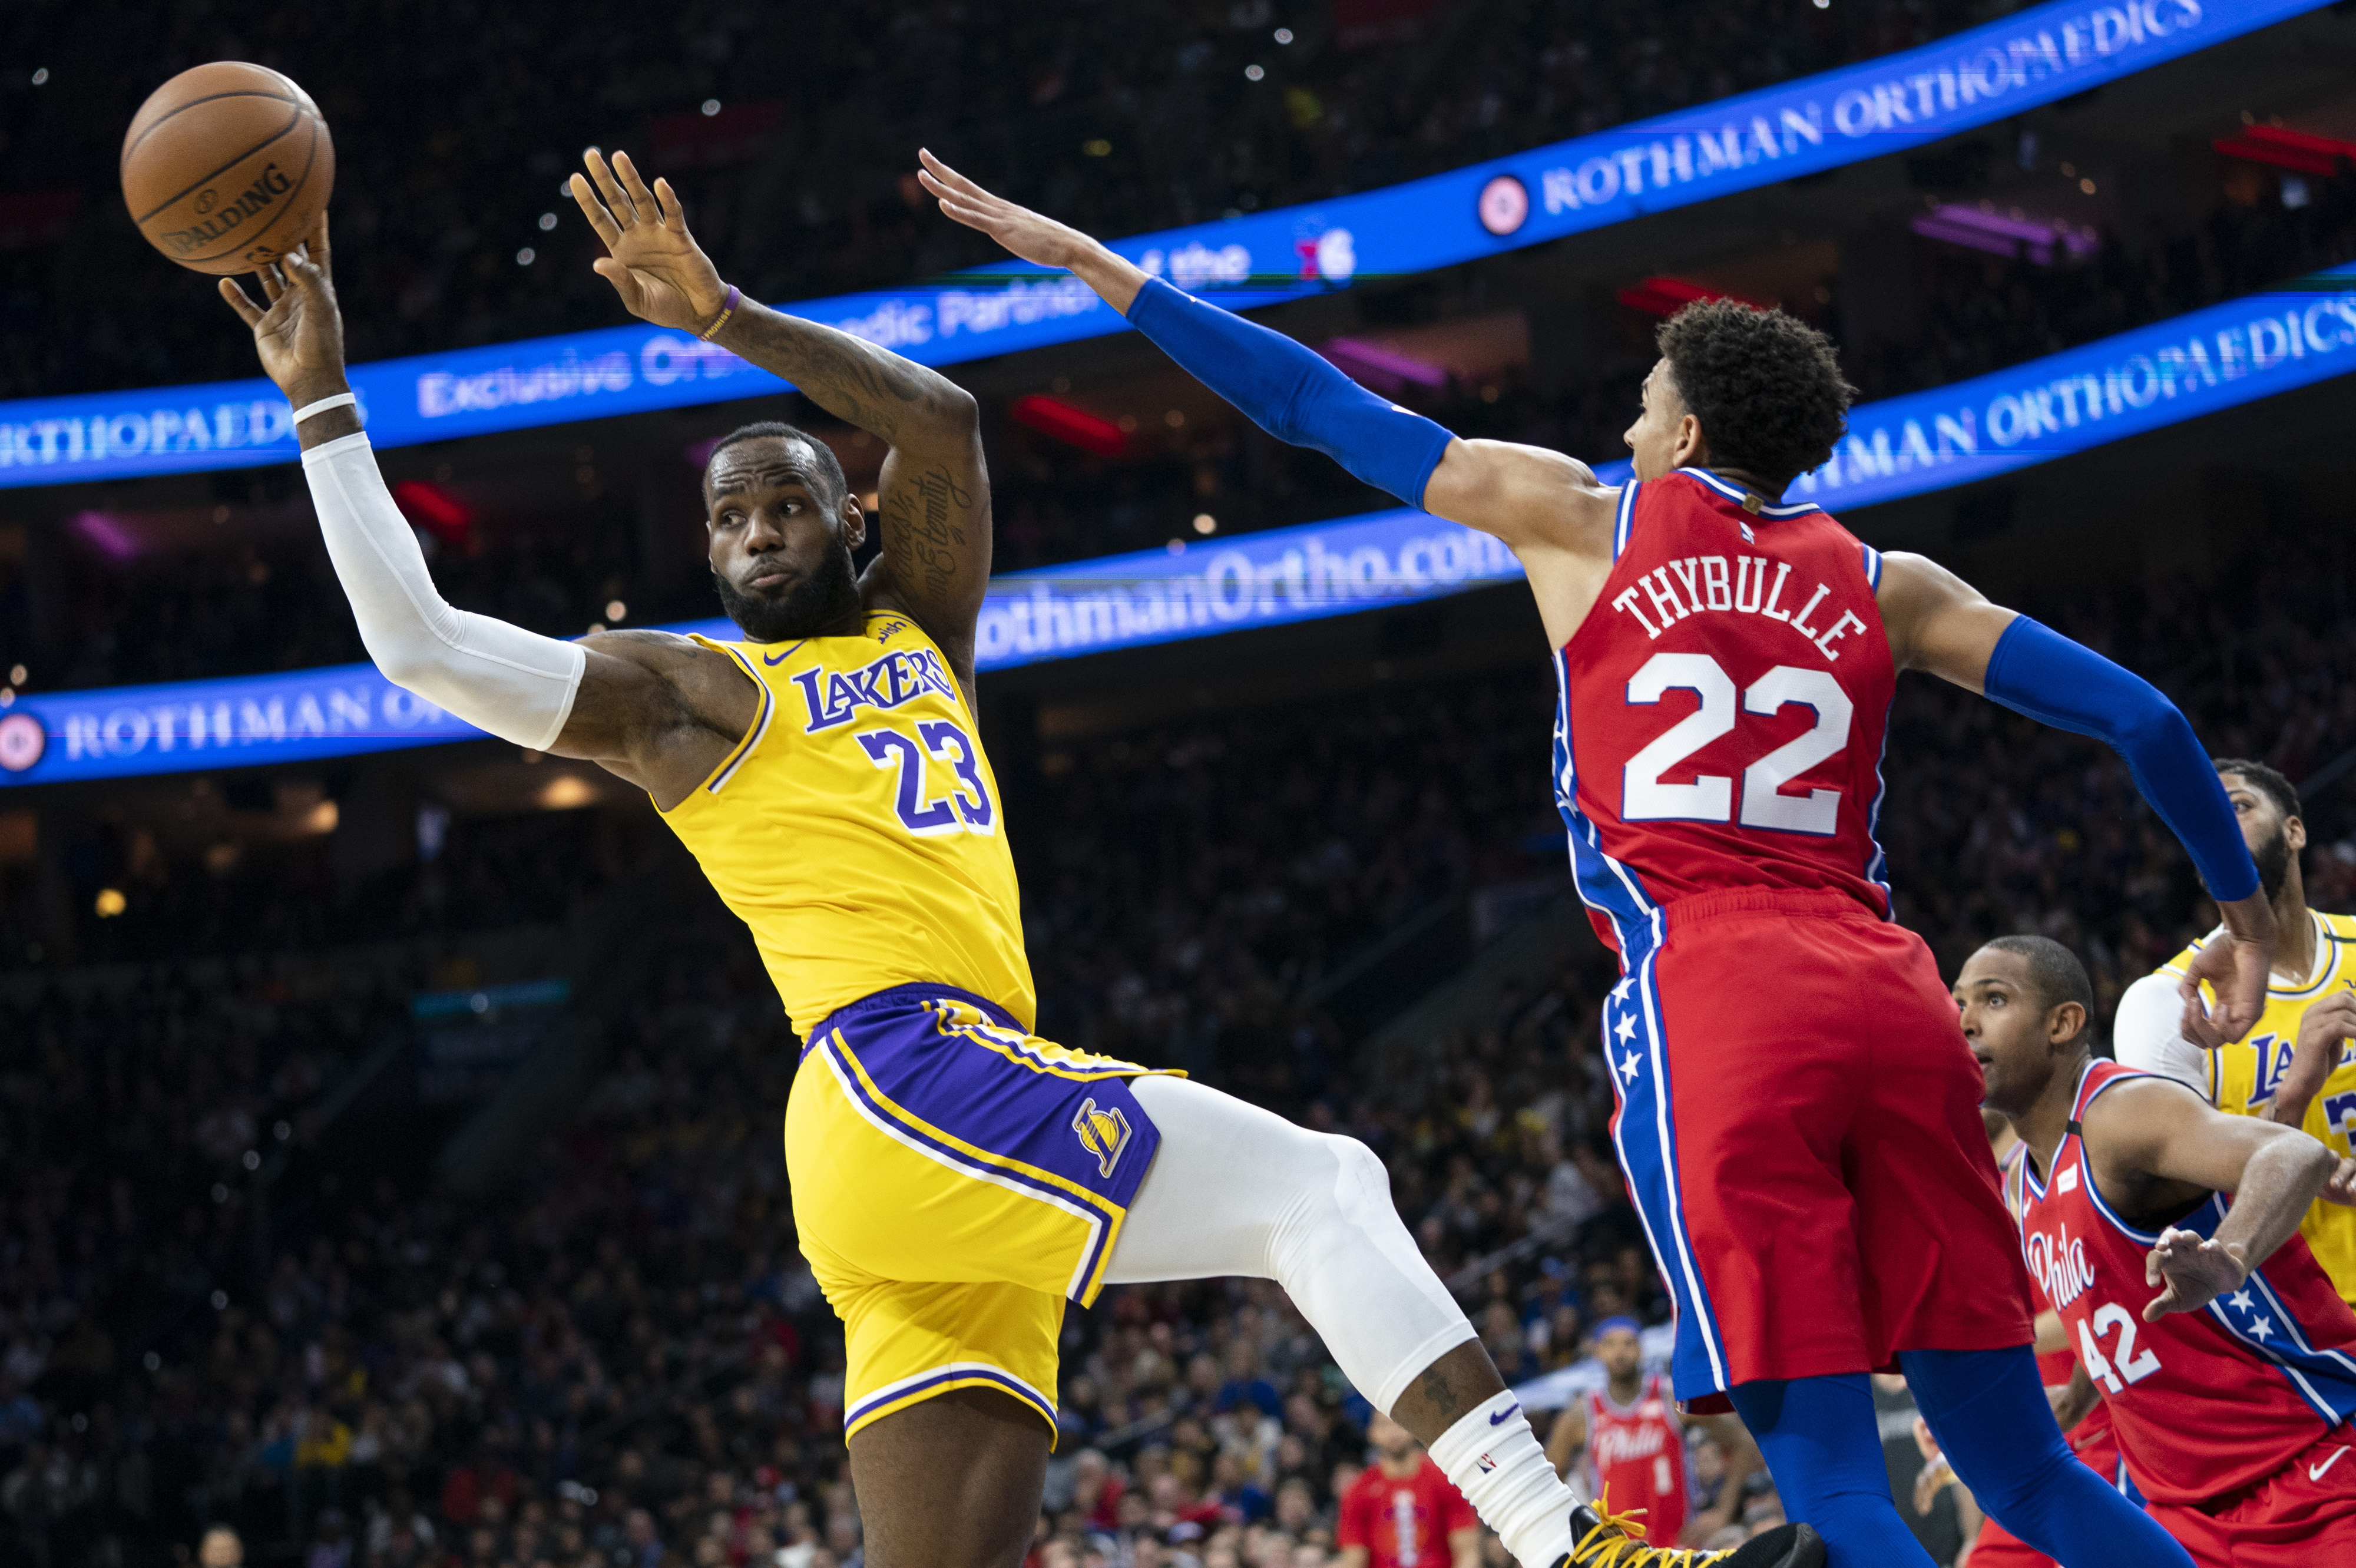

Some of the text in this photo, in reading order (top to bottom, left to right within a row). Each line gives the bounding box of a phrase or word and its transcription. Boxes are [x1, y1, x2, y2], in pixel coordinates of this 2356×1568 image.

[1541, 101, 1824, 216] ROTHMAN
[704, 307, 732, 339] PROMISE
[416, 348, 634, 418] Exclusive
[878, 621, 907, 645] wish
[975, 528, 1524, 661] othmanOrtho.com
[1611, 555, 1868, 662] THYBULLE
[64, 685, 372, 762] ROTHMAN
[790, 647, 958, 736] LAKERS
[852, 718, 997, 837] 23
[1620, 651, 1855, 838] 22
[2027, 1222, 2095, 1314] Phila
[2077, 1301, 2162, 1395] 42
